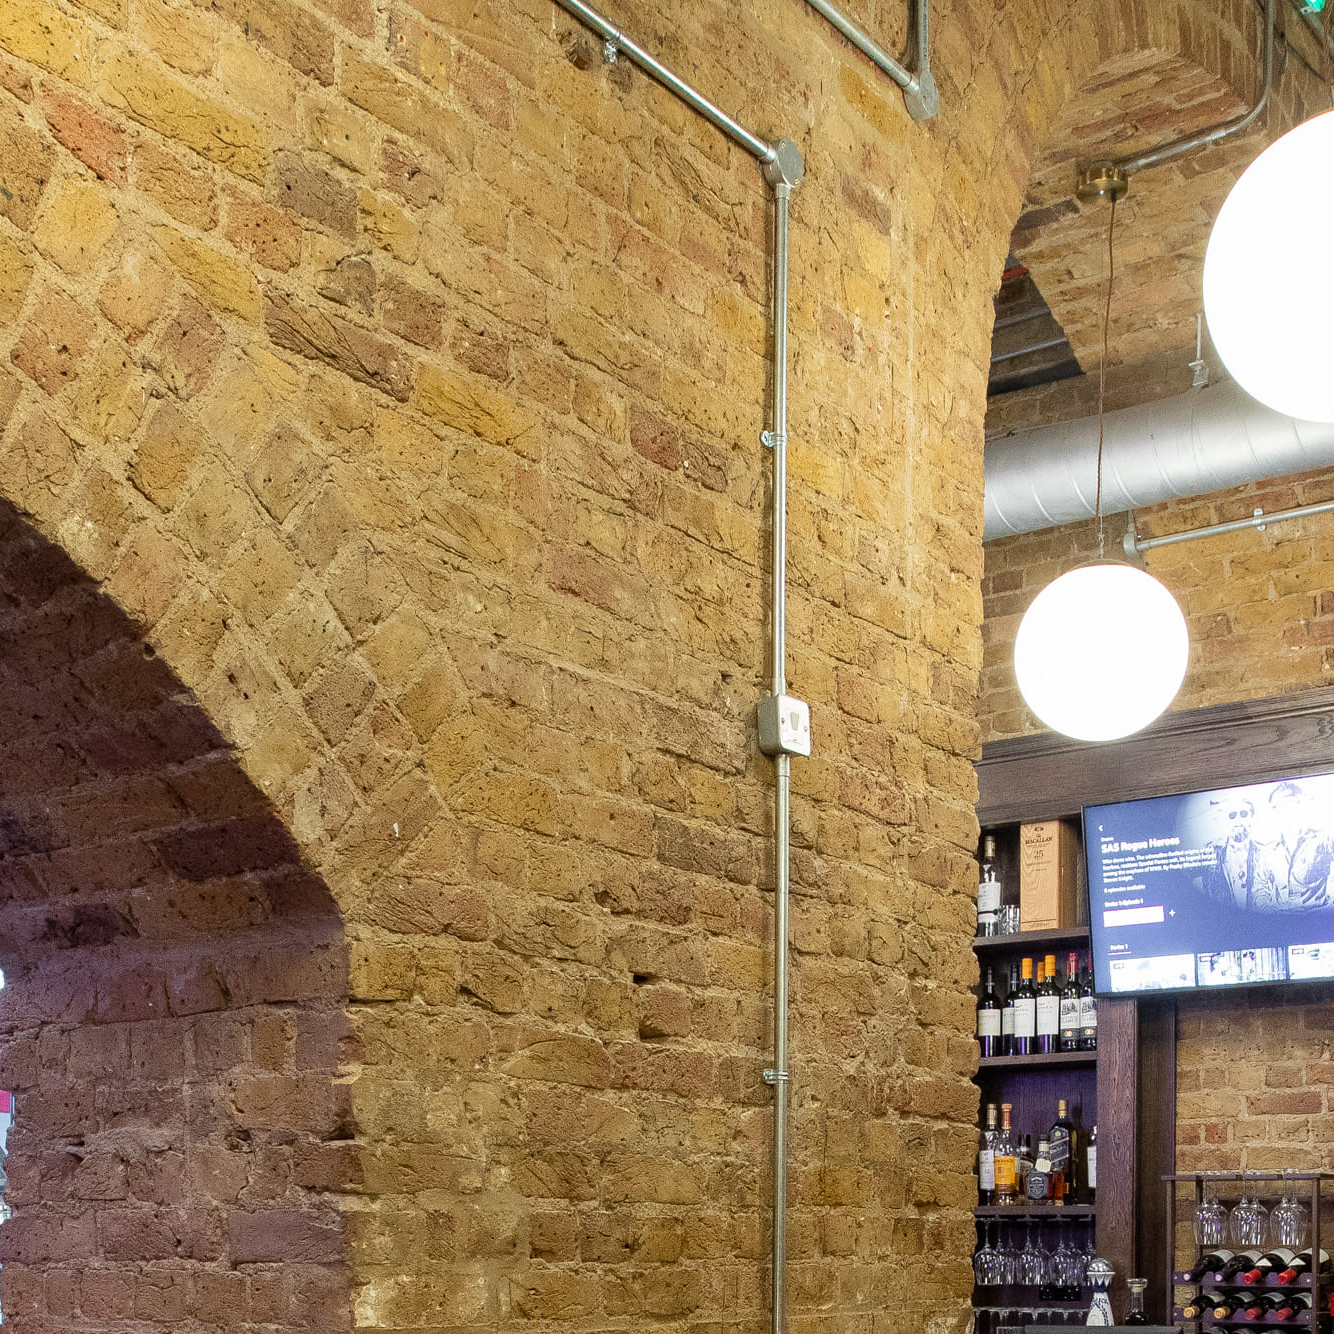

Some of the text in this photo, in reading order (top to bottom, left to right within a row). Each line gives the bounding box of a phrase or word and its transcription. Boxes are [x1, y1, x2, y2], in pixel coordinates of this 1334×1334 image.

[1025, 836, 1053, 845] MACALLAN
[1101, 837, 1180, 853] SAS Rogue Heroes
[1034, 850, 1044, 859] 25
